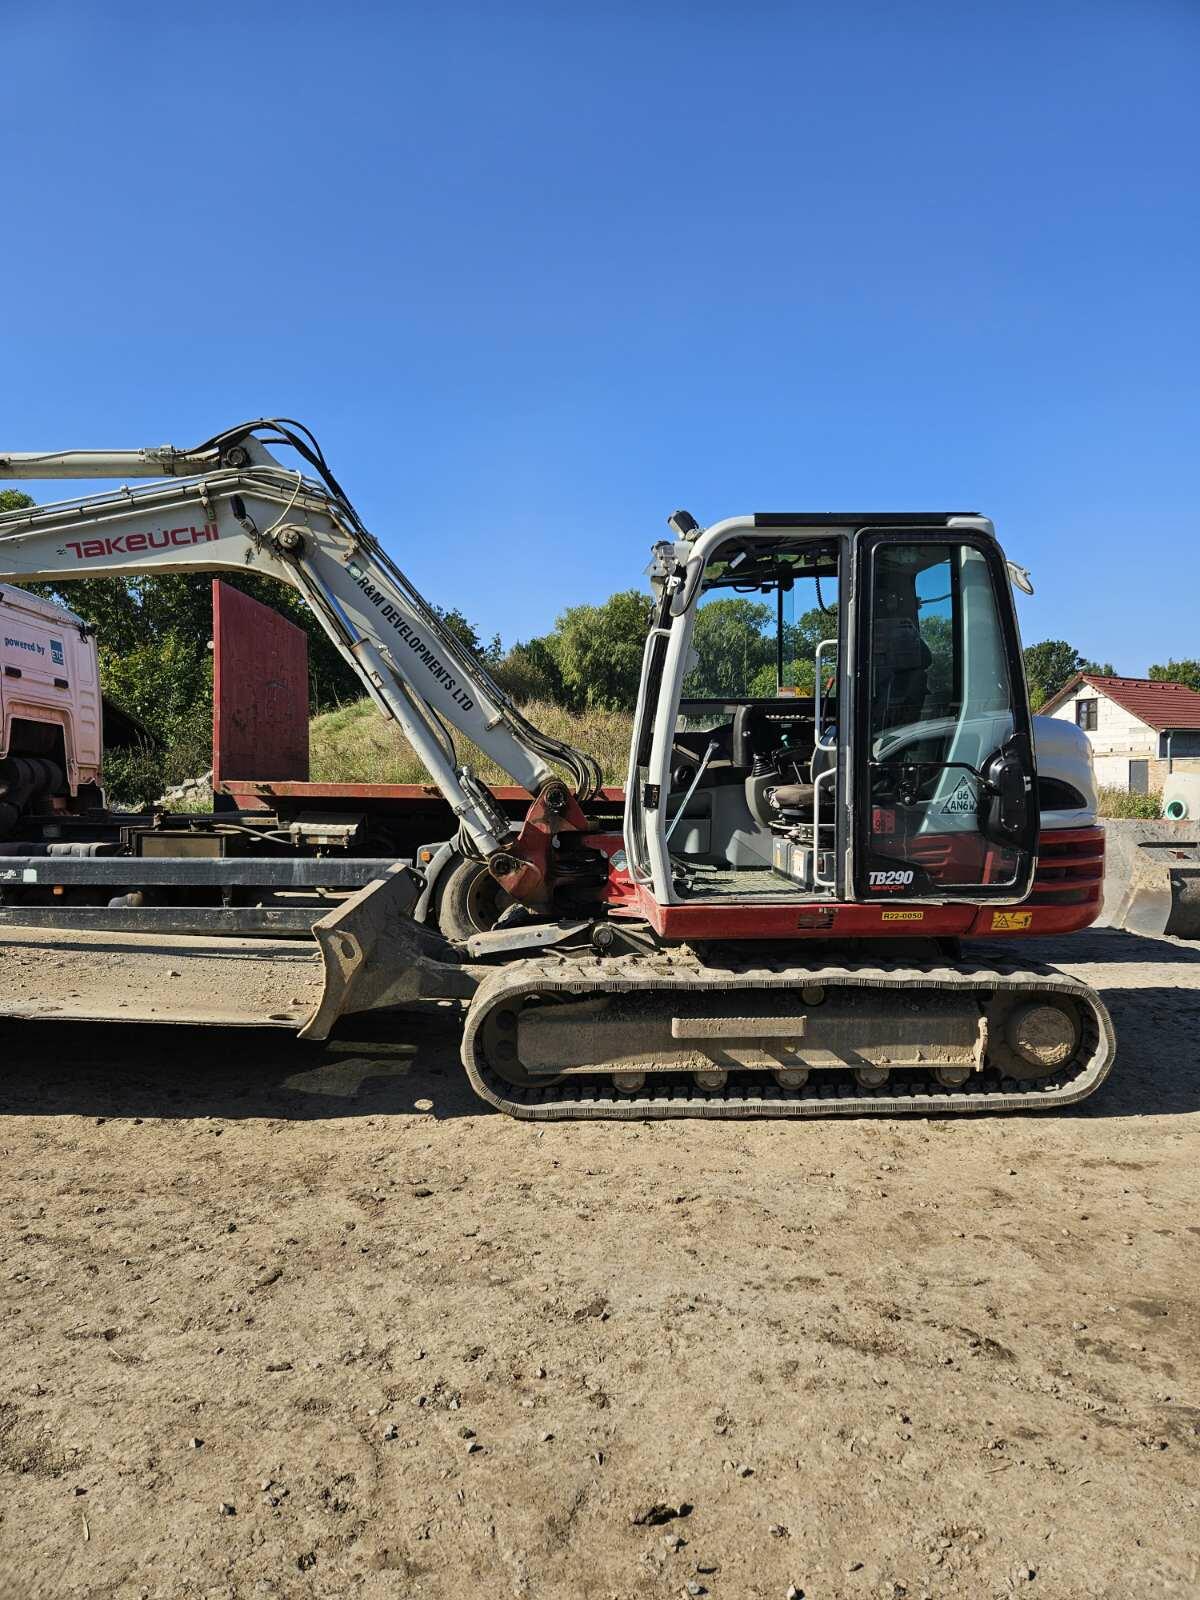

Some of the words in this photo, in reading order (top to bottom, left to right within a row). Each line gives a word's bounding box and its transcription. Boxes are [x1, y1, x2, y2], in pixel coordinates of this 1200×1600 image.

[4, 637, 35, 652] powered
[36, 643, 45, 656] by
[357, 577, 386, 606] R&M
[380, 605, 456, 690] DEVELOPMENTS
[451, 688, 474, 711] LTD
[869, 870, 914, 885] TB290
